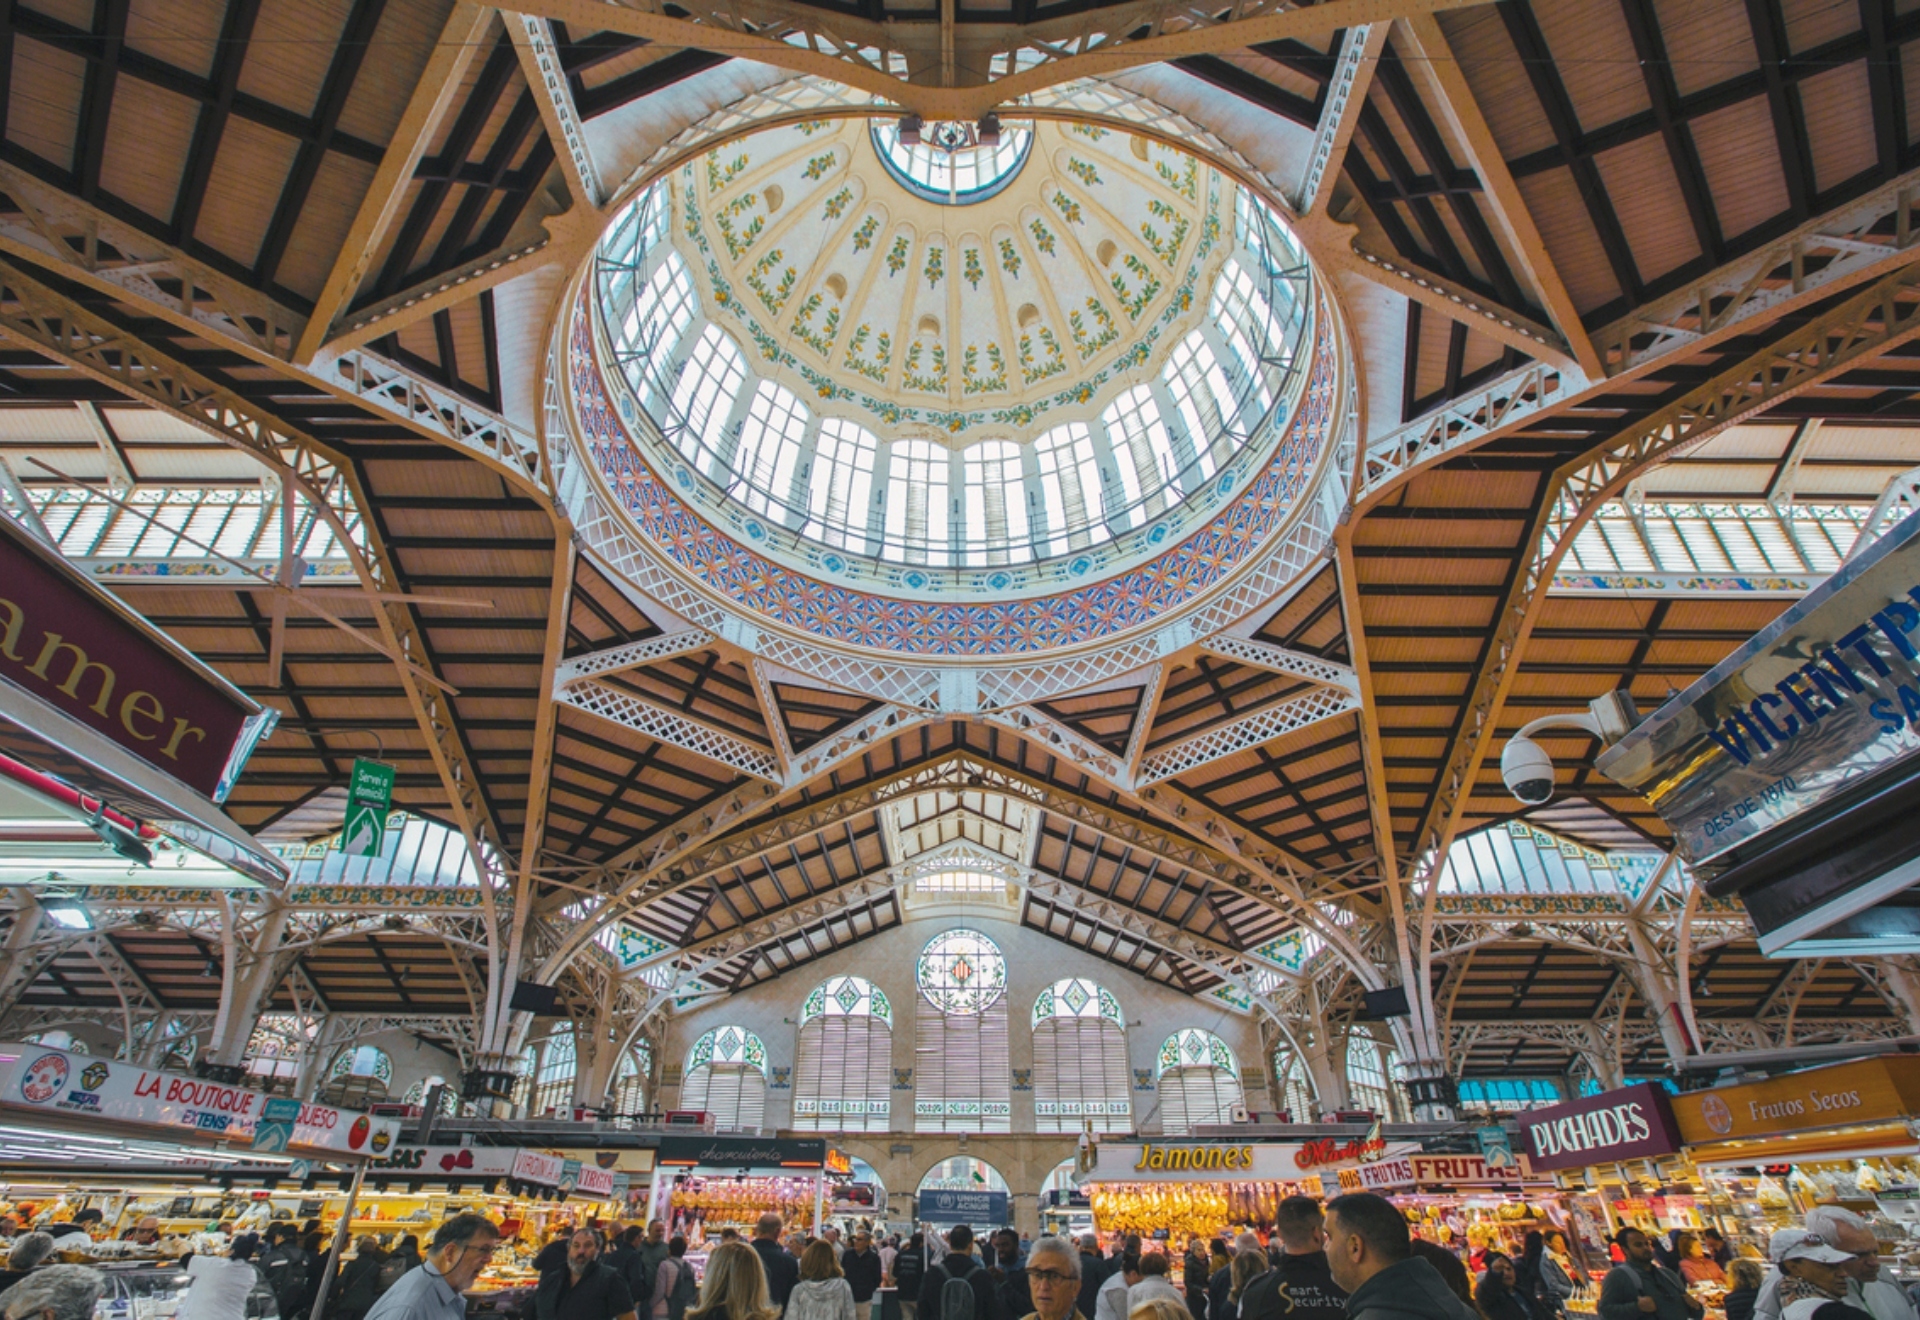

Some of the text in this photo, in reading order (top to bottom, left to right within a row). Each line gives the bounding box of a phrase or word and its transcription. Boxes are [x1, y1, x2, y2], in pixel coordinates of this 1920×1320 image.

[0, 597, 206, 761] amer
[1709, 585, 1920, 766] VICENT P
[1870, 676, 1920, 734] SA
[355, 785, 387, 800] domicili
[358, 769, 388, 787] Servei a
[1734, 796, 1759, 819] DE
[1760, 775, 1797, 804] 1870
[134, 1072, 161, 1099] LA
[165, 1078, 255, 1114] BOUTIQUE
[1748, 1087, 1861, 1122] Frutos Secos
[1529, 1102, 1651, 1158] PUCHADES
[515, 1153, 553, 1179] VIRGINIA
[1134, 1144, 1254, 1170] Jamones
[1363, 1159, 1414, 1184] FRUTAS
[577, 1167, 613, 1190] VIRGIN
[957, 1194, 990, 1202] UNHCR
